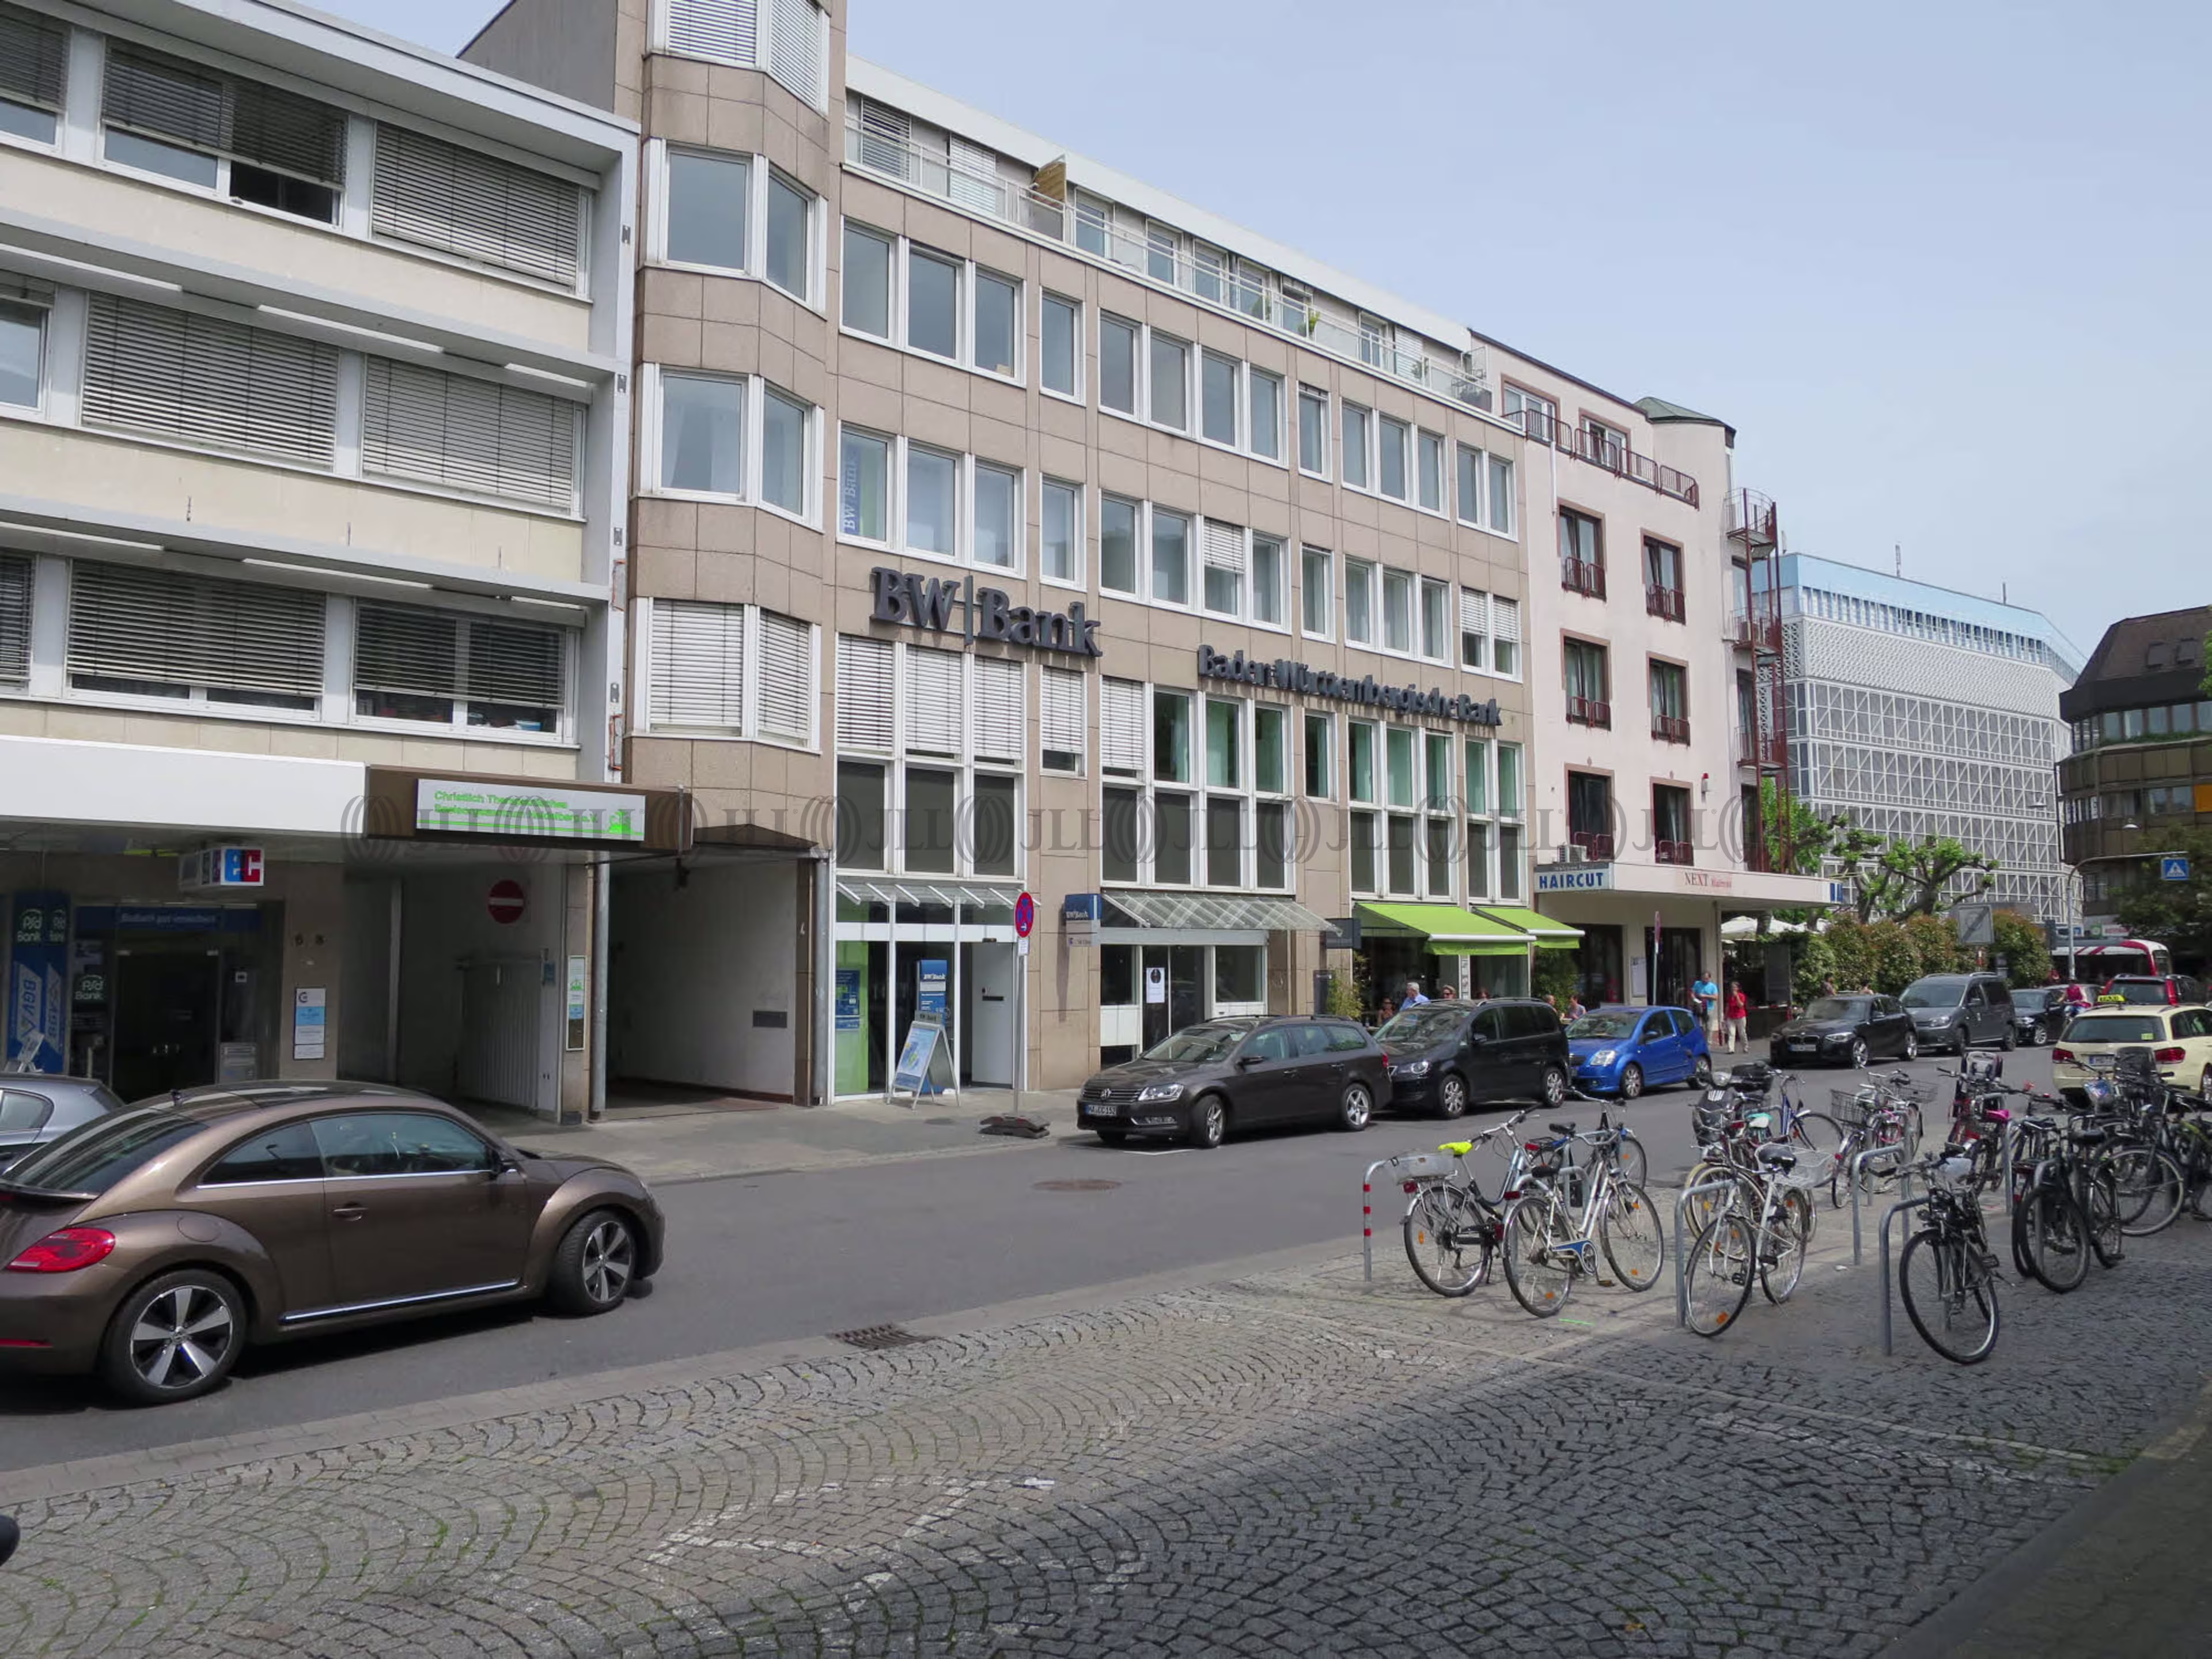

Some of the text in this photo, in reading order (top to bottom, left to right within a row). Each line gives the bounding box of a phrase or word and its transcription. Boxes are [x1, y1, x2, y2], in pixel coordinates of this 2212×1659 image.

[869, 566, 1104, 657] BW Bank
[1456, 694, 1503, 726] Bank
[1539, 872, 1604, 889] HAIRCUT
[1684, 872, 1708, 887] NEXT
